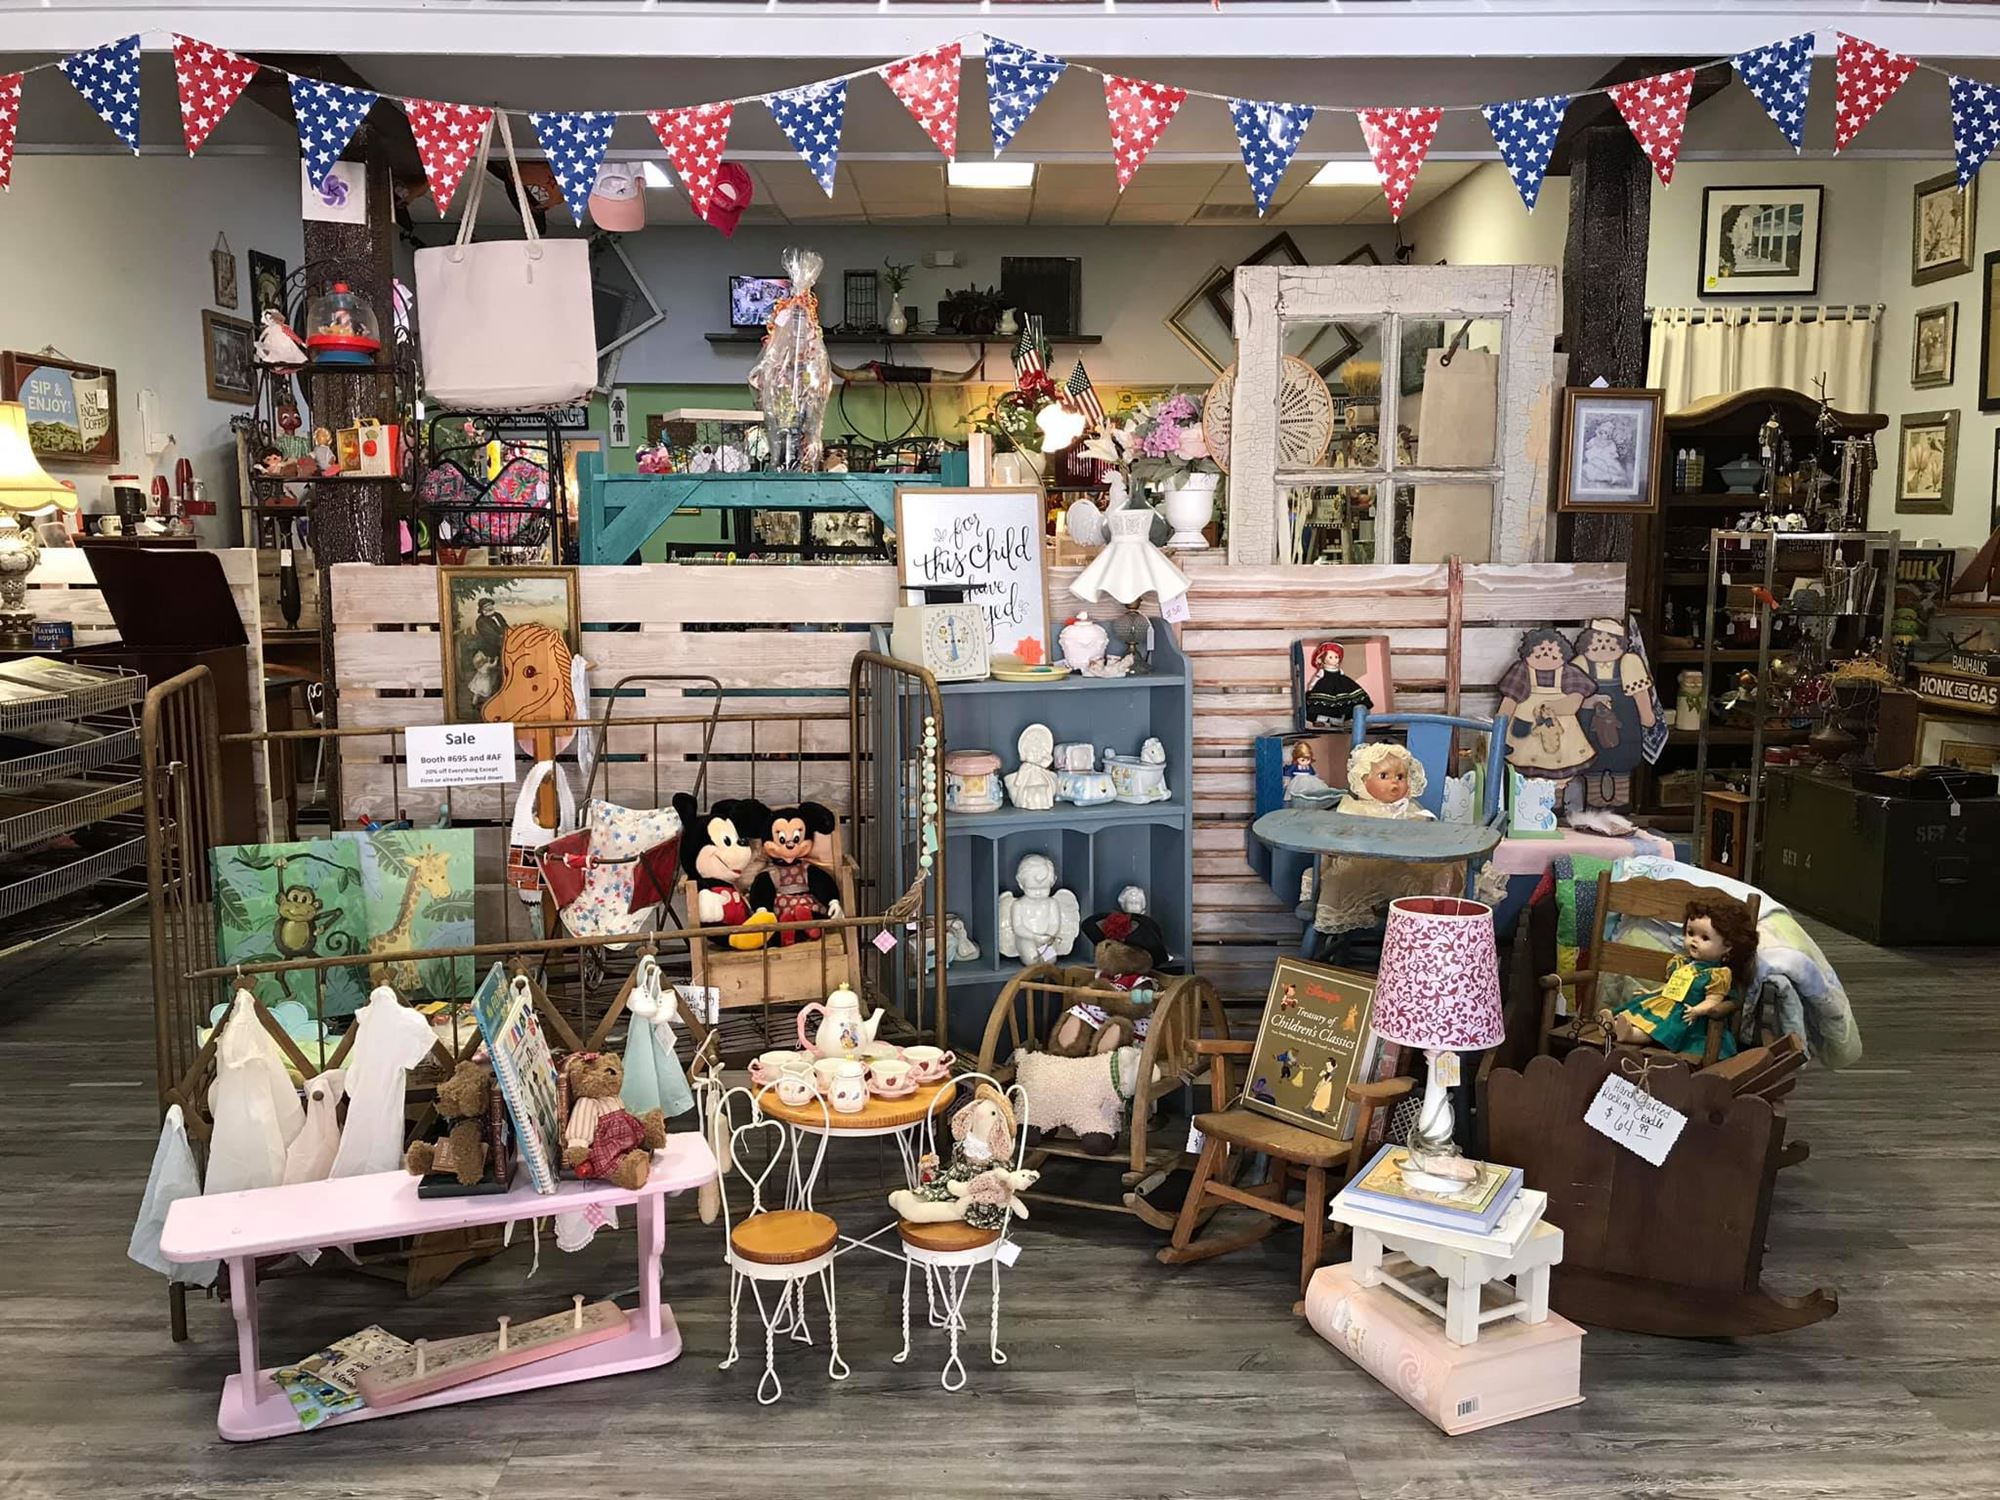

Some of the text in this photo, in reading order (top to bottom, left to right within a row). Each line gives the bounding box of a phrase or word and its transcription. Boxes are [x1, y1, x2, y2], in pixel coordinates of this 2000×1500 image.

[30, 380, 62, 397] SIP &
[28, 396, 72, 414] ENJOY!
[949, 513, 983, 549] for
[914, 546, 967, 582] this
[1952, 655, 1988, 676] BAUHAUS
[1919, 676, 1998, 704] HONK FOR GAS
[446, 732, 476, 745] Sale
[421, 756, 446, 764] Booth
[1782, 848, 1797, 867] SET
[1296, 1007, 1340, 1028] Treasury of
[1271, 1014, 1317, 1038] Children's
[1319, 1029, 1356, 1050] Classics
